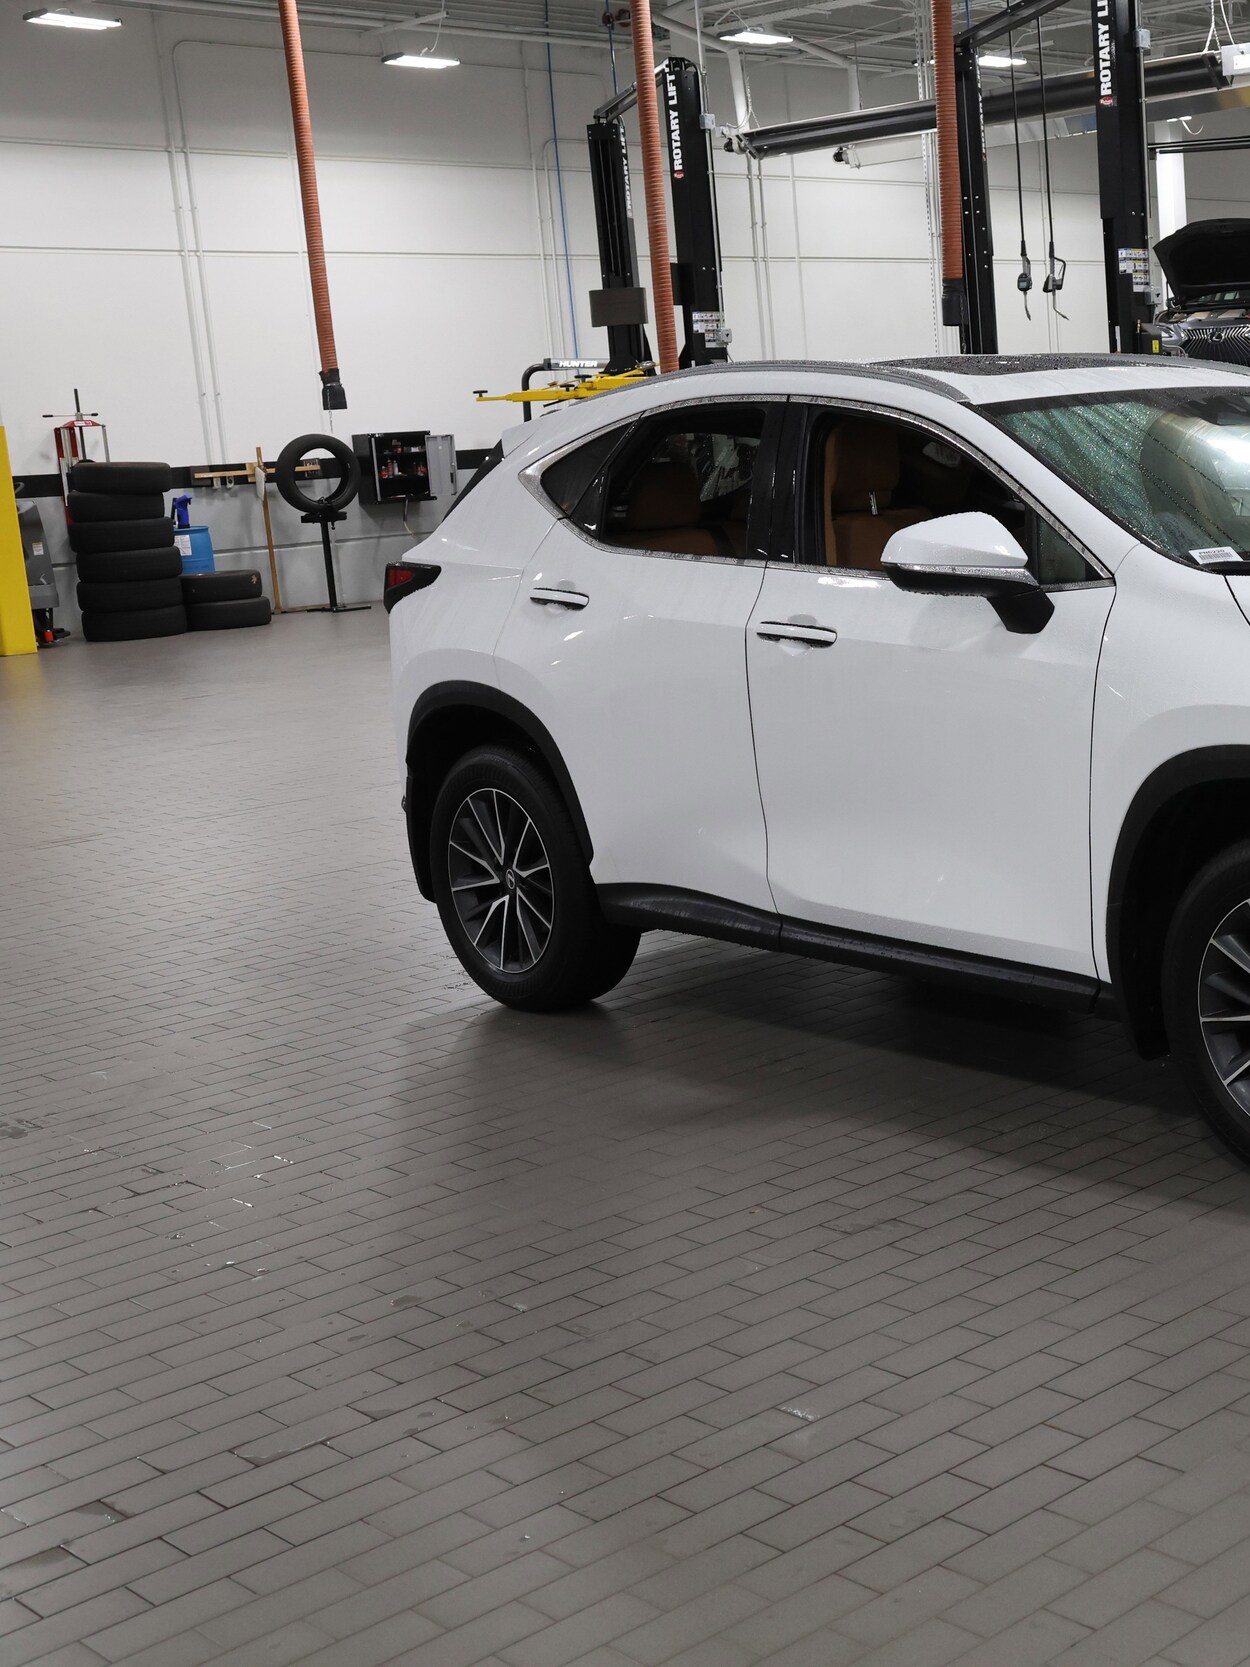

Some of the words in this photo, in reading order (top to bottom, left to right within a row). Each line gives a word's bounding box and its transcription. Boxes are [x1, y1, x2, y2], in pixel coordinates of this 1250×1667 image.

[1098, 22, 1112, 96] ROTARY
[666, 73, 678, 106] LIFT
[669, 109, 684, 171] ROTARY
[559, 360, 598, 368] HUNTER
